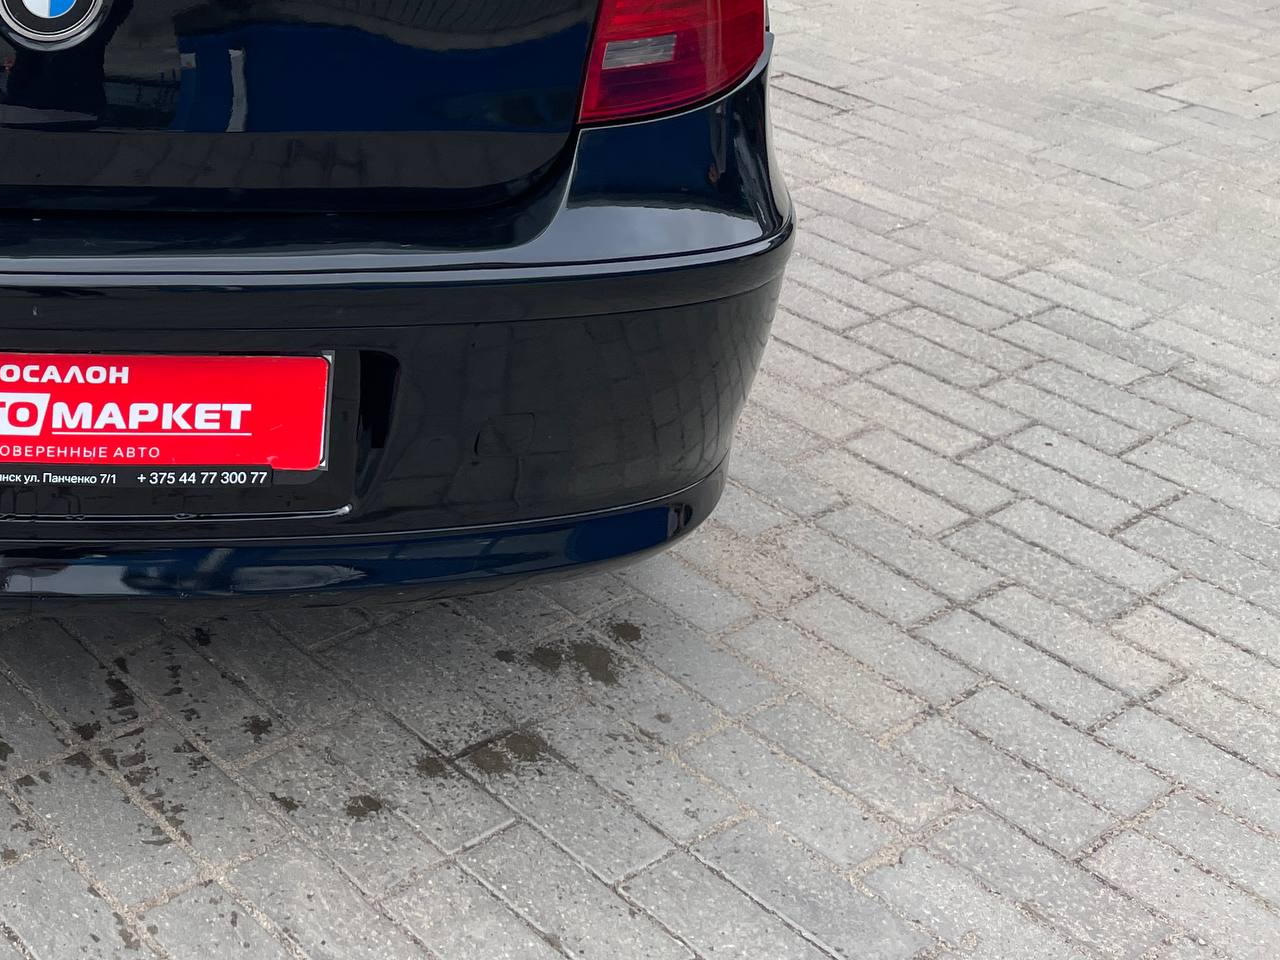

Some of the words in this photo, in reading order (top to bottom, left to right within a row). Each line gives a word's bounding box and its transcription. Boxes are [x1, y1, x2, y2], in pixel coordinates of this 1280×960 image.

[113, 446, 160, 458] АВТО
[23, 473, 40, 485] ул.
[42, 472, 97, 485] Панченко
[99, 473, 116, 485] 7/1
[149, 472, 175, 485] 375
[178, 472, 196, 485] 44
[200, 472, 219, 485] 77
[220, 471, 247, 485] 300
[250, 471, 267, 485] 77
